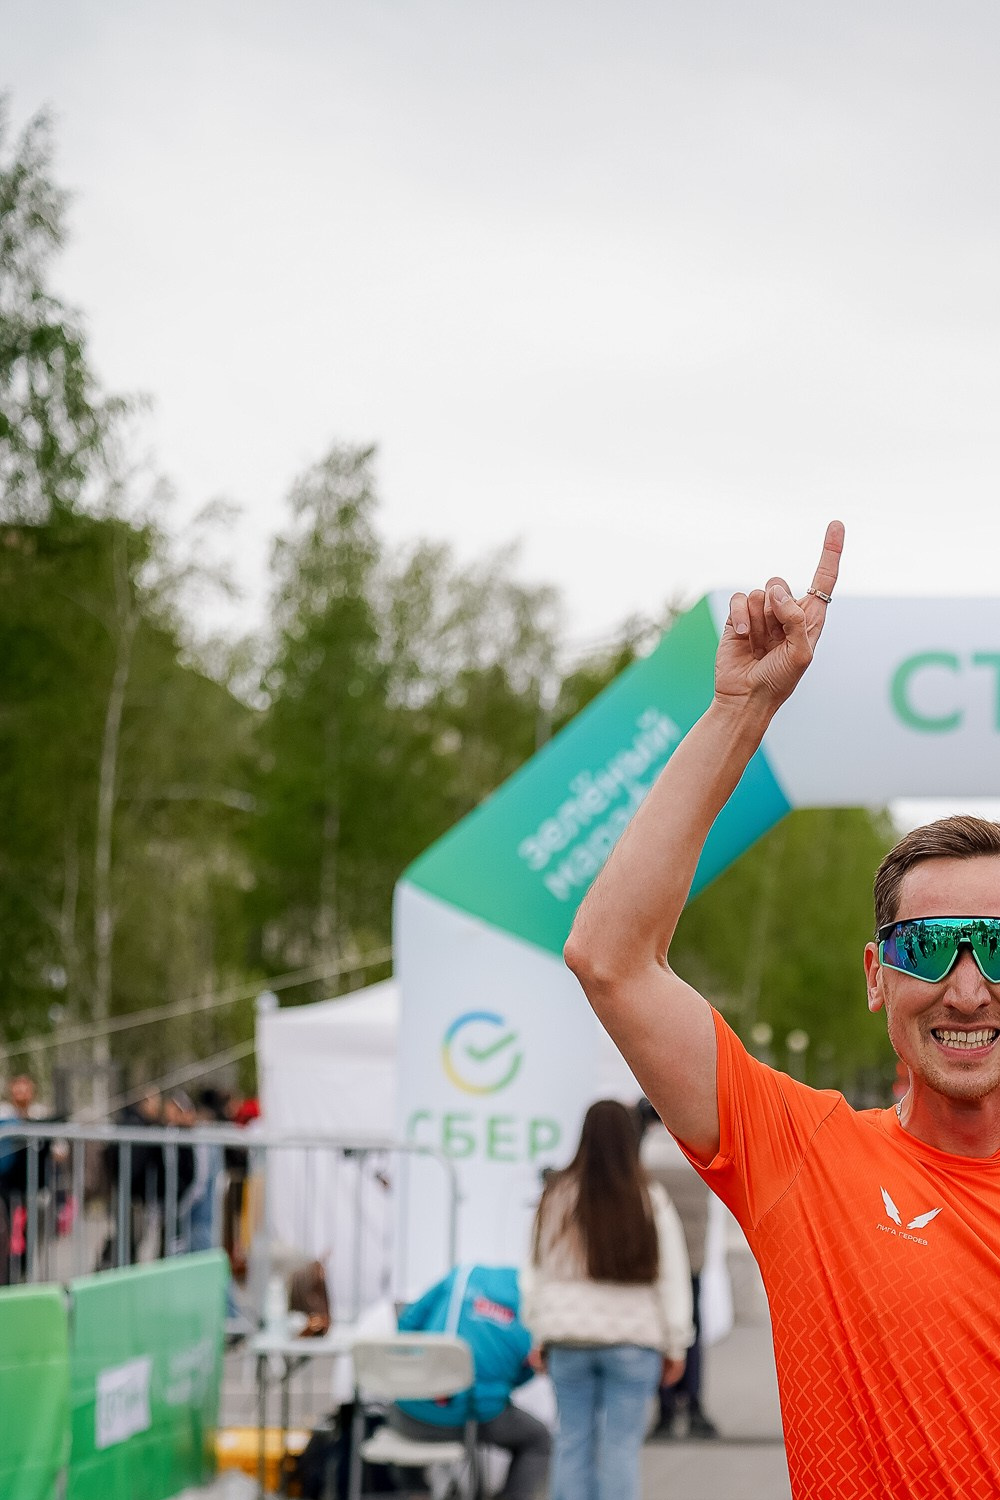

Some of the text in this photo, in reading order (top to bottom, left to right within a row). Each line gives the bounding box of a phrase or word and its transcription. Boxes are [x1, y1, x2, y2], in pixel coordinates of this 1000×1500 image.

[406, 1110, 561, 1162] СБЕР
[876, 1223, 928, 1246] ЛИГА ГЕРОЕВ
